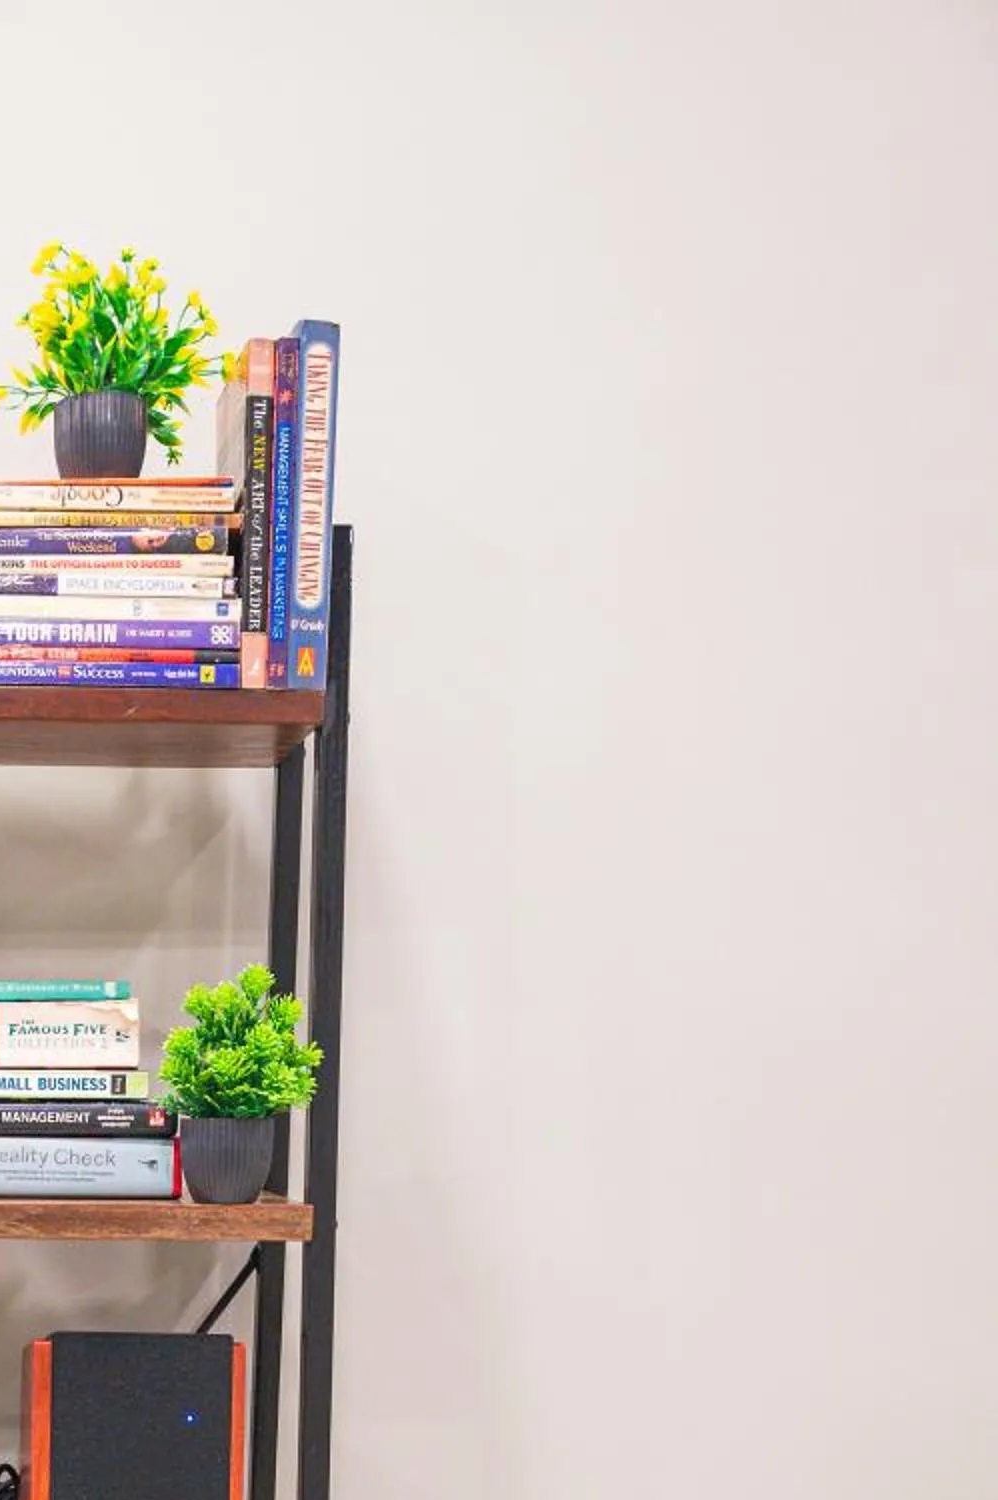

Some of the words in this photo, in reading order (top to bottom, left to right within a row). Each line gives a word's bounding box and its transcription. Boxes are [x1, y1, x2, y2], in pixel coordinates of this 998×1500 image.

[253, 400, 266, 428] The
[252, 434, 266, 471] NEW
[277, 427, 290, 505] MANAGEMENT
[50, 485, 123, 508] Google
[251, 479, 264, 512] ART
[250, 514, 263, 535] of
[275, 507, 288, 552] SKILLS
[66, 540, 117, 553] Weekend
[250, 536, 263, 560] the
[30, 560, 49, 569] THE
[125, 560, 138, 569] TO
[140, 560, 182, 569] SUCCESS
[275, 557, 287, 571] IN
[65, 579, 100, 591] SPACE
[103, 579, 185, 592] ENCYCLOPEDIA
[248, 566, 262, 630] LEADER
[272, 573, 285, 639] MARKETING
[5, 623, 53, 642] YOUR
[59, 623, 118, 643] BRAIN
[8, 1023, 68, 1036] FAMOUS
[73, 1023, 107, 1036] FIVE
[37, 1077, 107, 1091] BUSINESS
[2, 1112, 90, 1123] MANAGEMENT
[53, 1147, 116, 1168] Check
